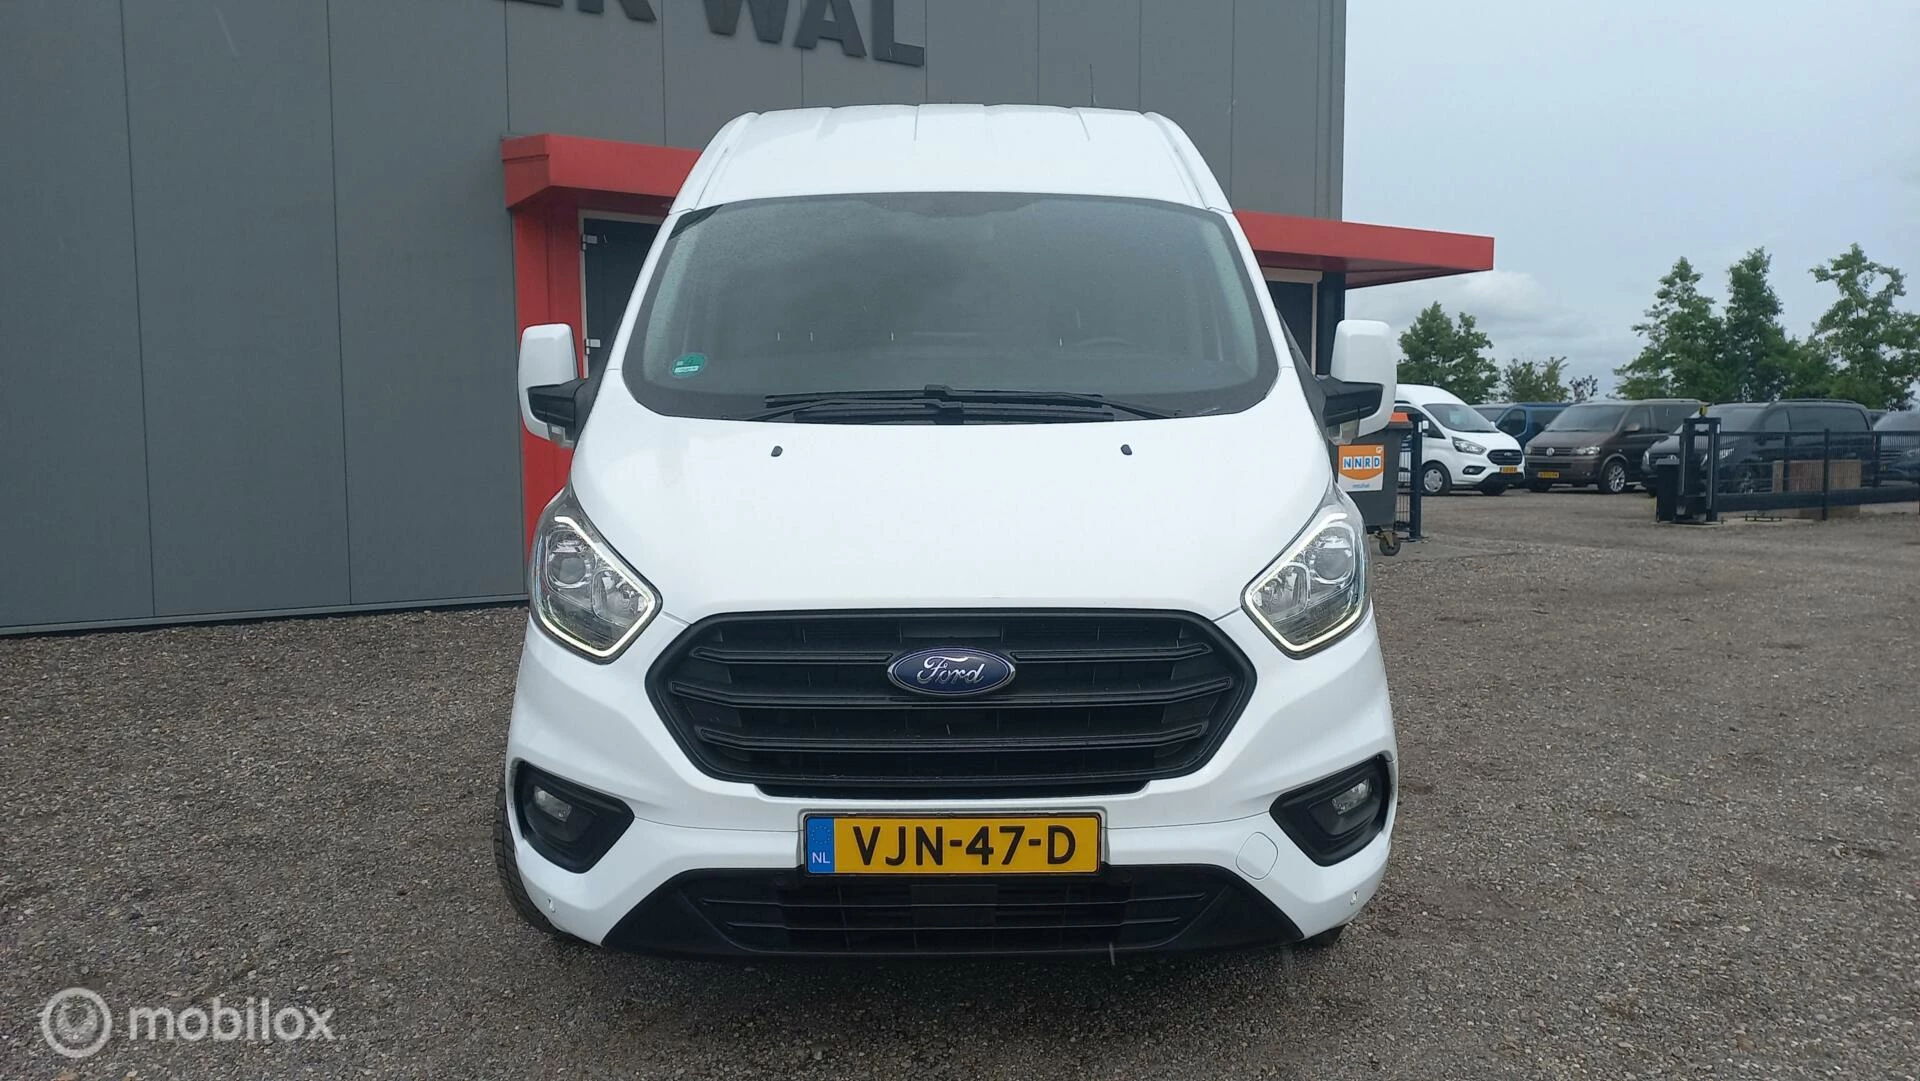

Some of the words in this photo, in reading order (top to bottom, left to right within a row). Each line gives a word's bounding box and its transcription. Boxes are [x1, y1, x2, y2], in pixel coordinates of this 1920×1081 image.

[1343, 456, 1381, 468] NNRD
[916, 655, 986, 685] Ford
[852, 825, 1077, 866] VJN-47-D
[812, 851, 831, 864] NL
